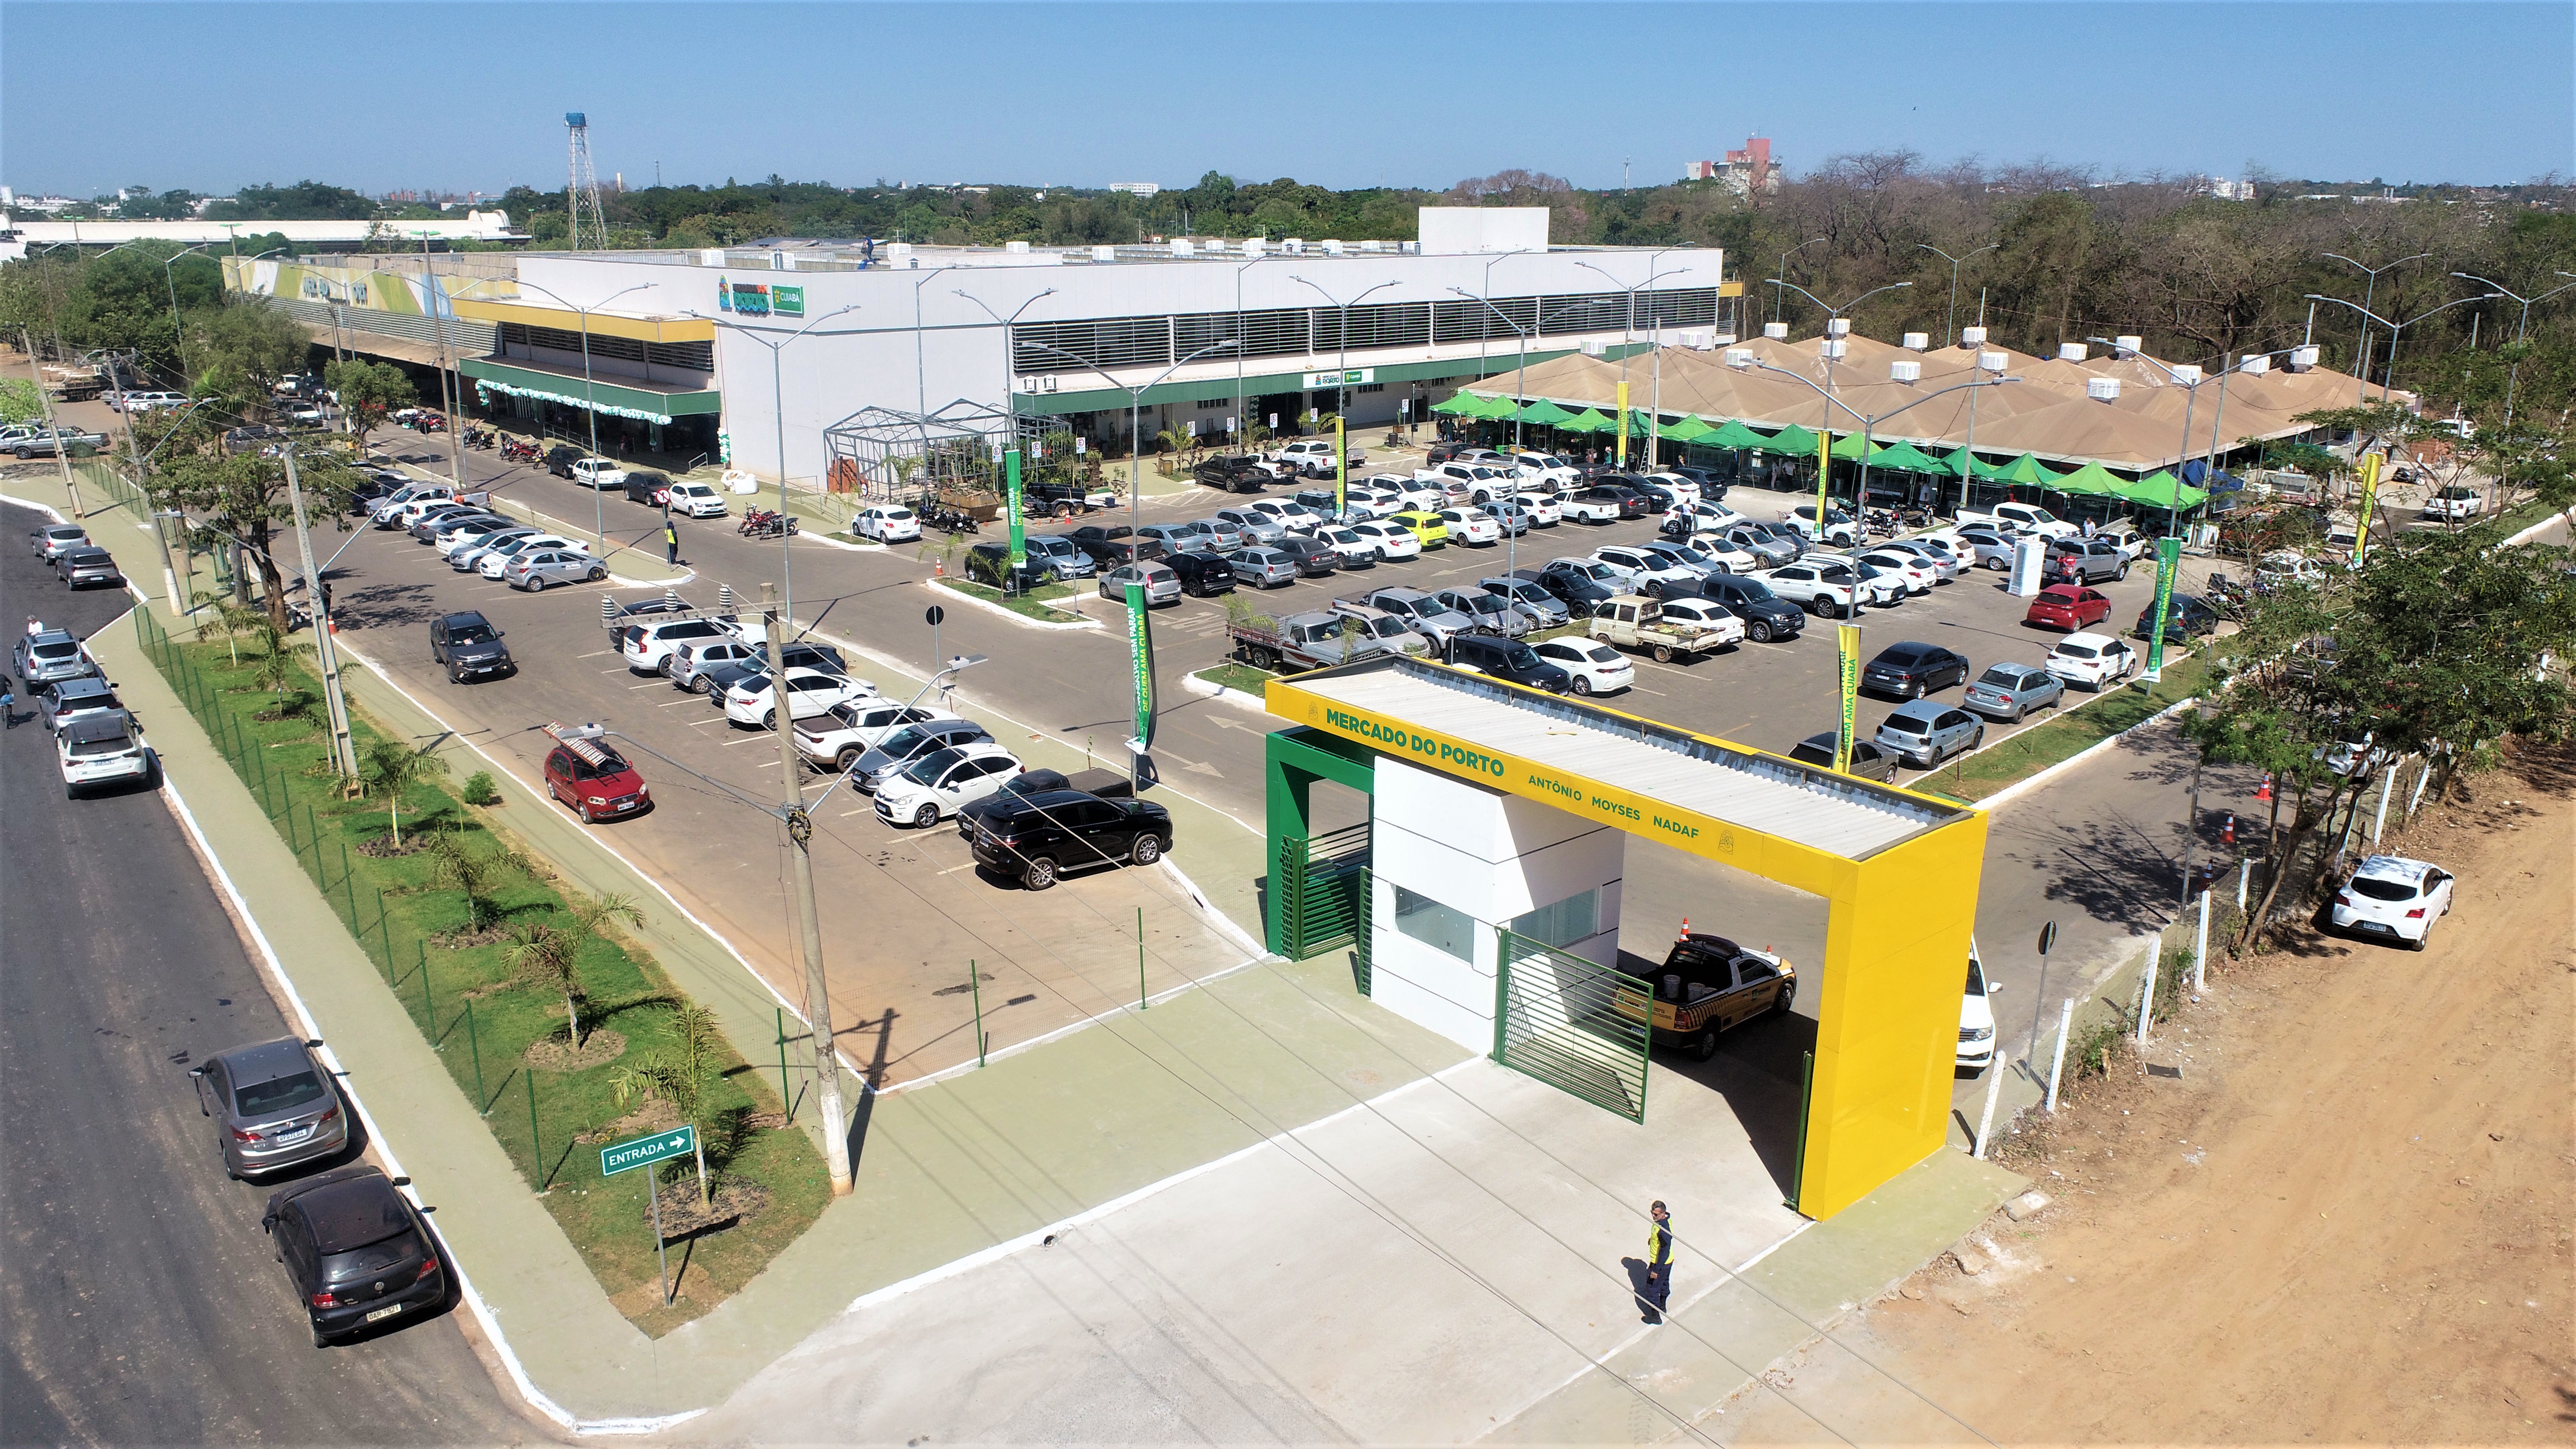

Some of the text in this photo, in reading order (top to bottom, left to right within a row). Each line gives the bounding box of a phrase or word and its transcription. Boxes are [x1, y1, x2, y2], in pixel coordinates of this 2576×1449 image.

[780, 291, 800, 303] CUIABÁ
[1819, 491, 1823, 499] DE
[1017, 516, 1022, 526] DE
[1128, 607, 1137, 637] PARAR
[1135, 613, 1146, 647] CUIABÁ
[1130, 638, 1138, 659] SEM
[1143, 700, 1148, 712] DE
[1845, 697, 1853, 720] AMA
[1327, 708, 1505, 776] MERCADO DO PORTO
[1528, 775, 1699, 838] ANTÔNIO MOYSES NADAF
[609, 1142, 666, 1166] ENTRADA
